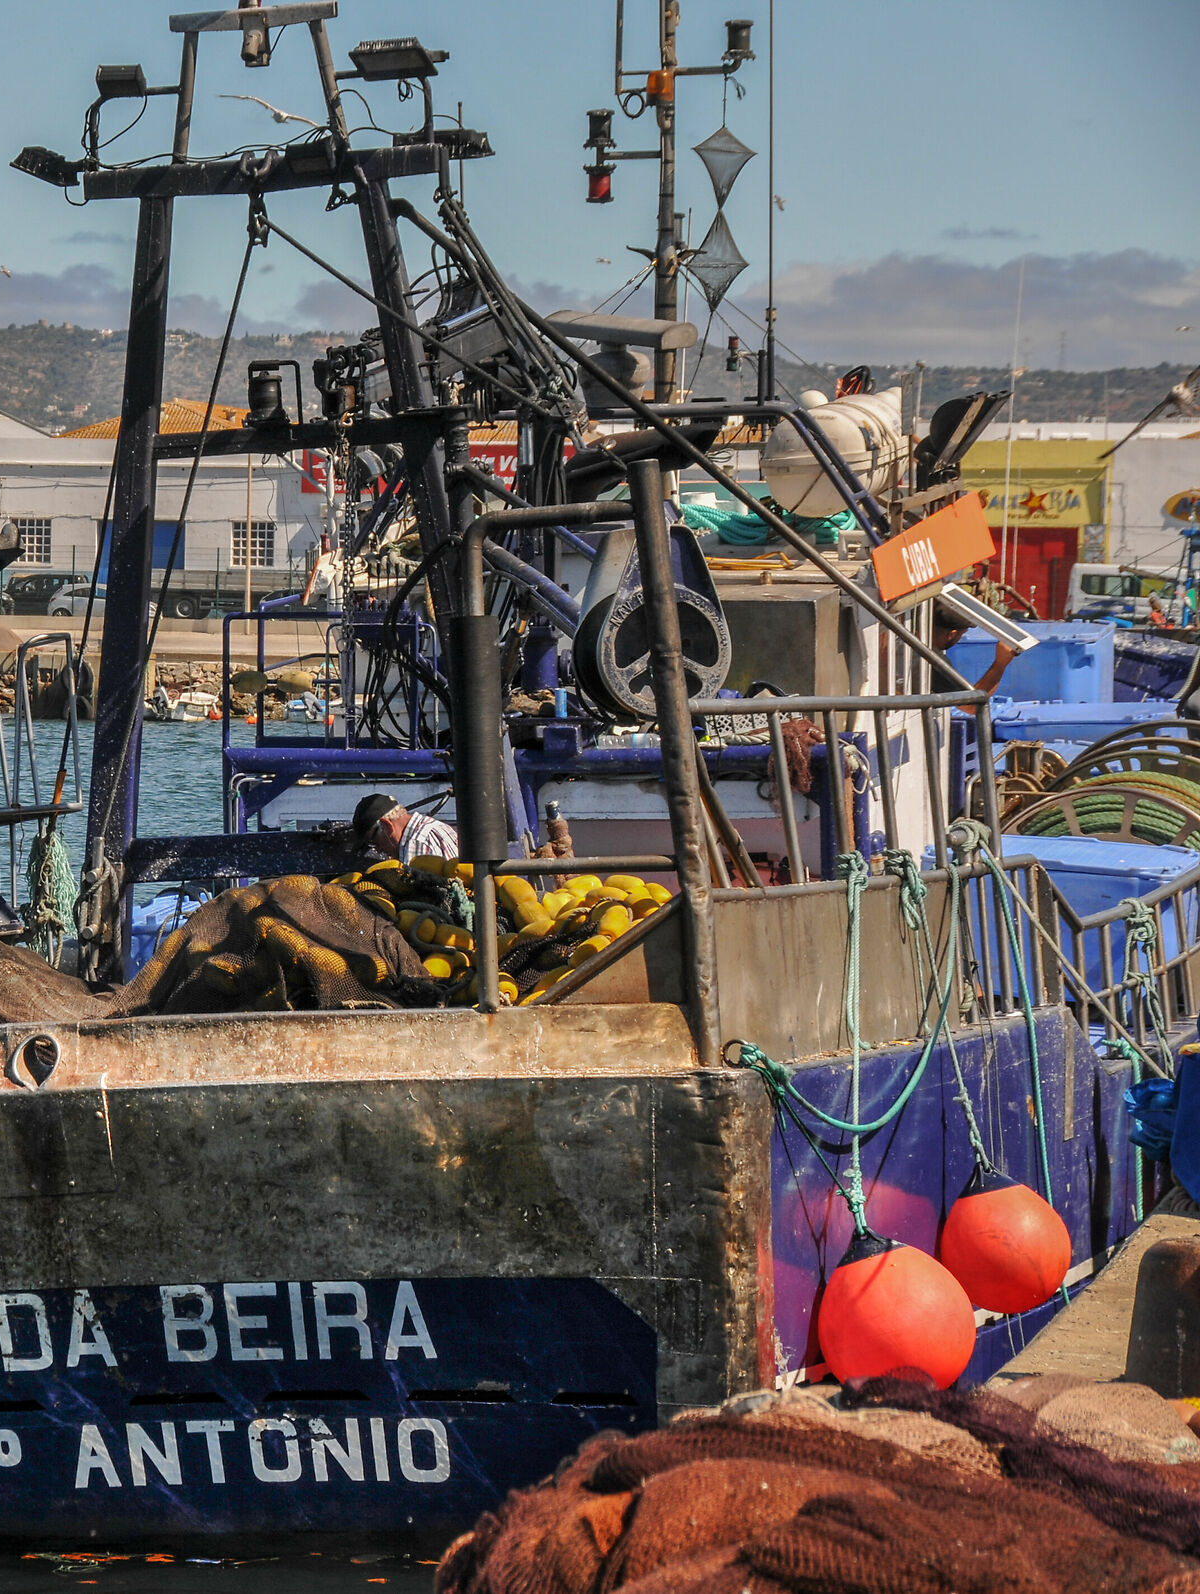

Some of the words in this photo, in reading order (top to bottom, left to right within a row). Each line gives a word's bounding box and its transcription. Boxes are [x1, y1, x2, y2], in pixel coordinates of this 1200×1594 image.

[610, 600, 634, 628] NAV
[158, 1280, 438, 1362] BEIRA
[75, 1417, 451, 1489] ANTONIO
